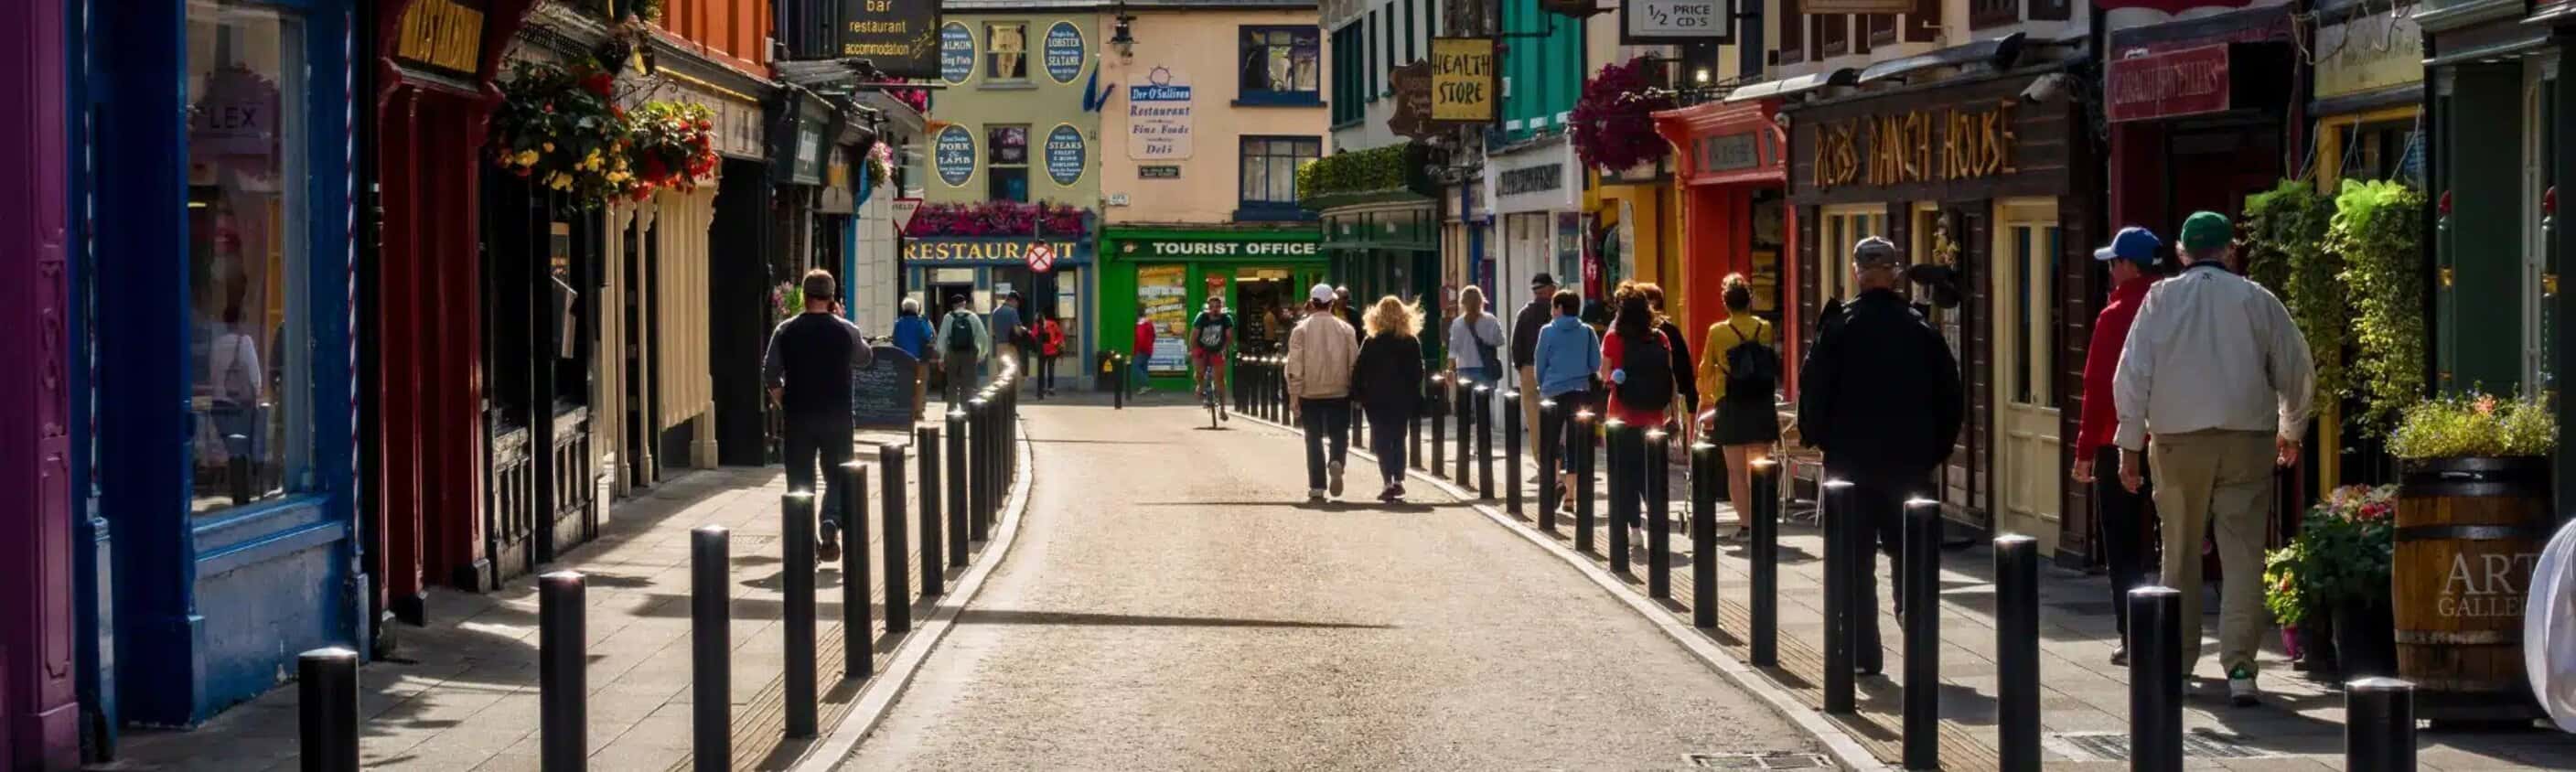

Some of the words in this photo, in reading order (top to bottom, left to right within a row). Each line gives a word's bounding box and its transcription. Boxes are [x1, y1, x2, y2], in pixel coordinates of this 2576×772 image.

[866, 0, 892, 12] bar
[1673, 5, 1712, 16] PRICE
[849, 20, 907, 33] restaurant
[1676, 17, 1708, 27] CD'S
[844, 42, 909, 56] accommodation
[940, 39, 972, 50] ALMON
[1433, 53, 1491, 76] HEALTH
[1439, 80, 1484, 104] STORE
[1130, 105, 1190, 117] Restaurant
[1132, 124, 1156, 134] Fine
[1161, 124, 1188, 134] Foods
[939, 142, 970, 150] PORK
[1868, 110, 1931, 186] RANCH
[1942, 99, 2016, 180] HOUSE
[1145, 145, 1172, 154] Deli
[939, 156, 971, 165] LAMB
[904, 242, 1076, 260] RESTAURT
[1153, 241, 1239, 255] TOURIST
[1246, 241, 1316, 255] OFFICE
